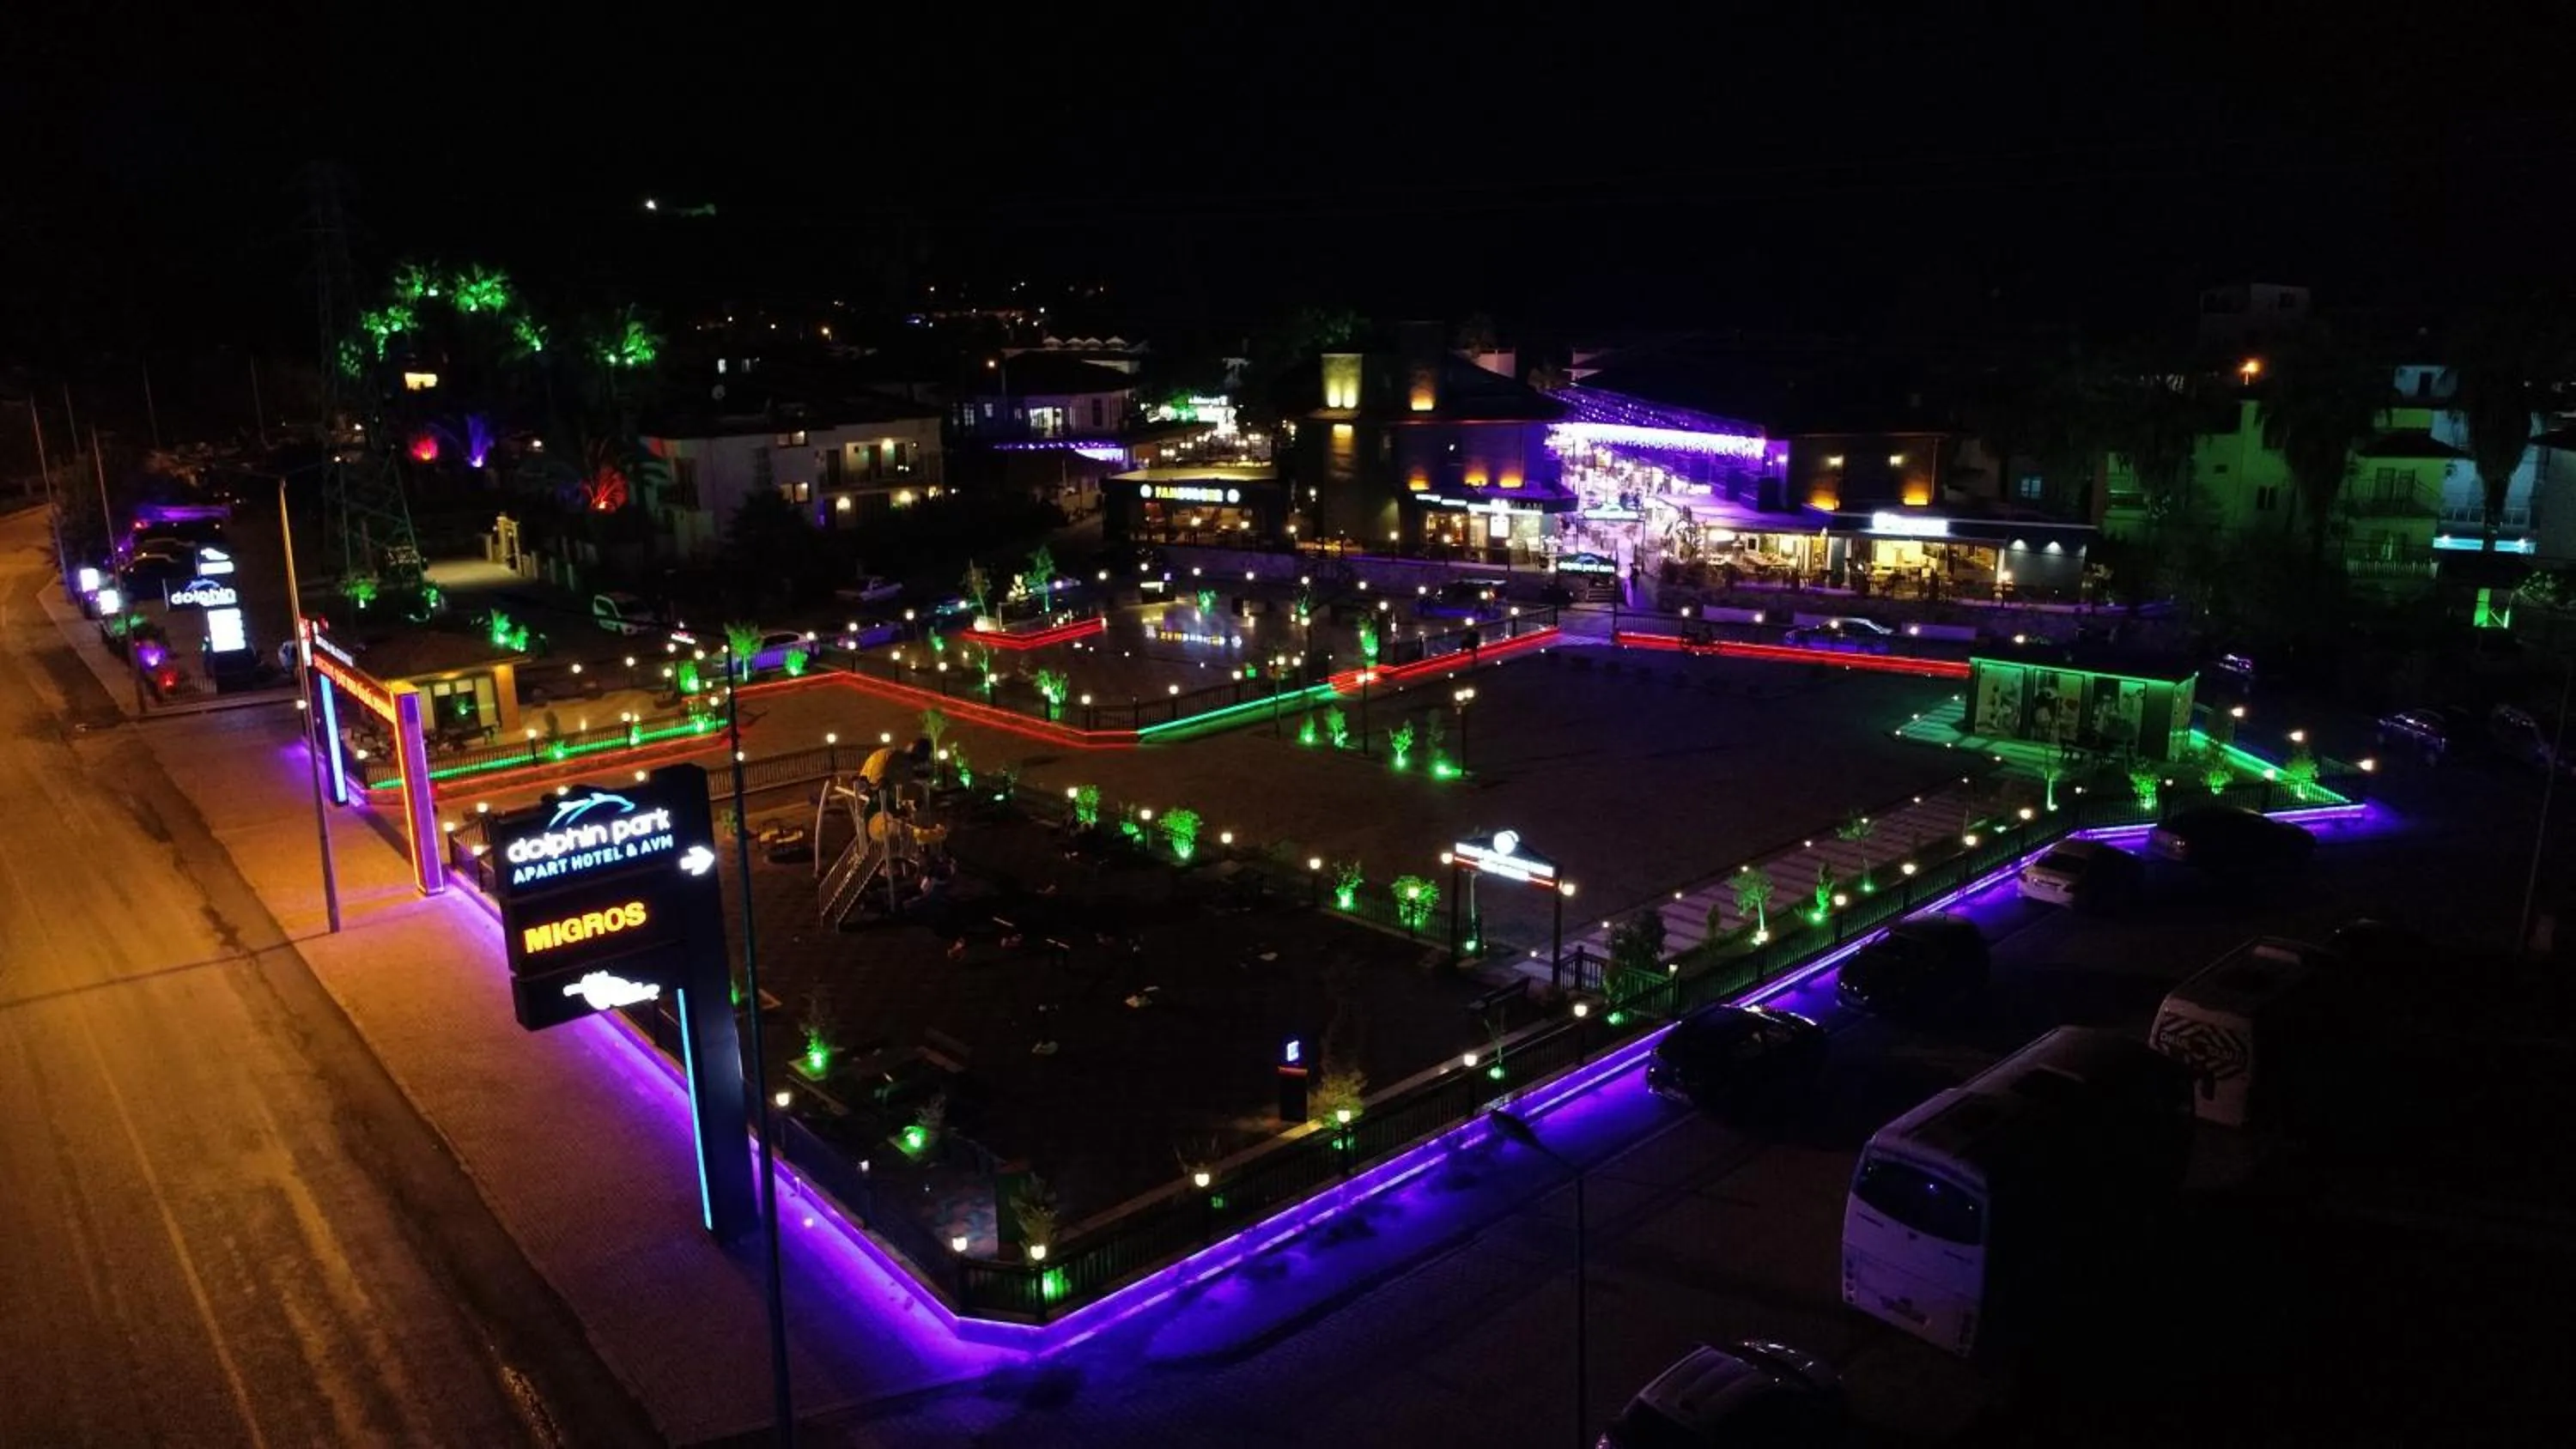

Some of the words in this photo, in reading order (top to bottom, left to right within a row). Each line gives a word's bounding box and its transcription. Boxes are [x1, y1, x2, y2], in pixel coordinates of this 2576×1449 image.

[507, 823, 608, 863] dolphin
[611, 808, 671, 845] park
[513, 858, 568, 884] APART
[571, 846, 623, 871] HOTEL
[626, 842, 638, 857] &
[641, 834, 674, 854] AVM
[523, 901, 647, 954] MIGROS
